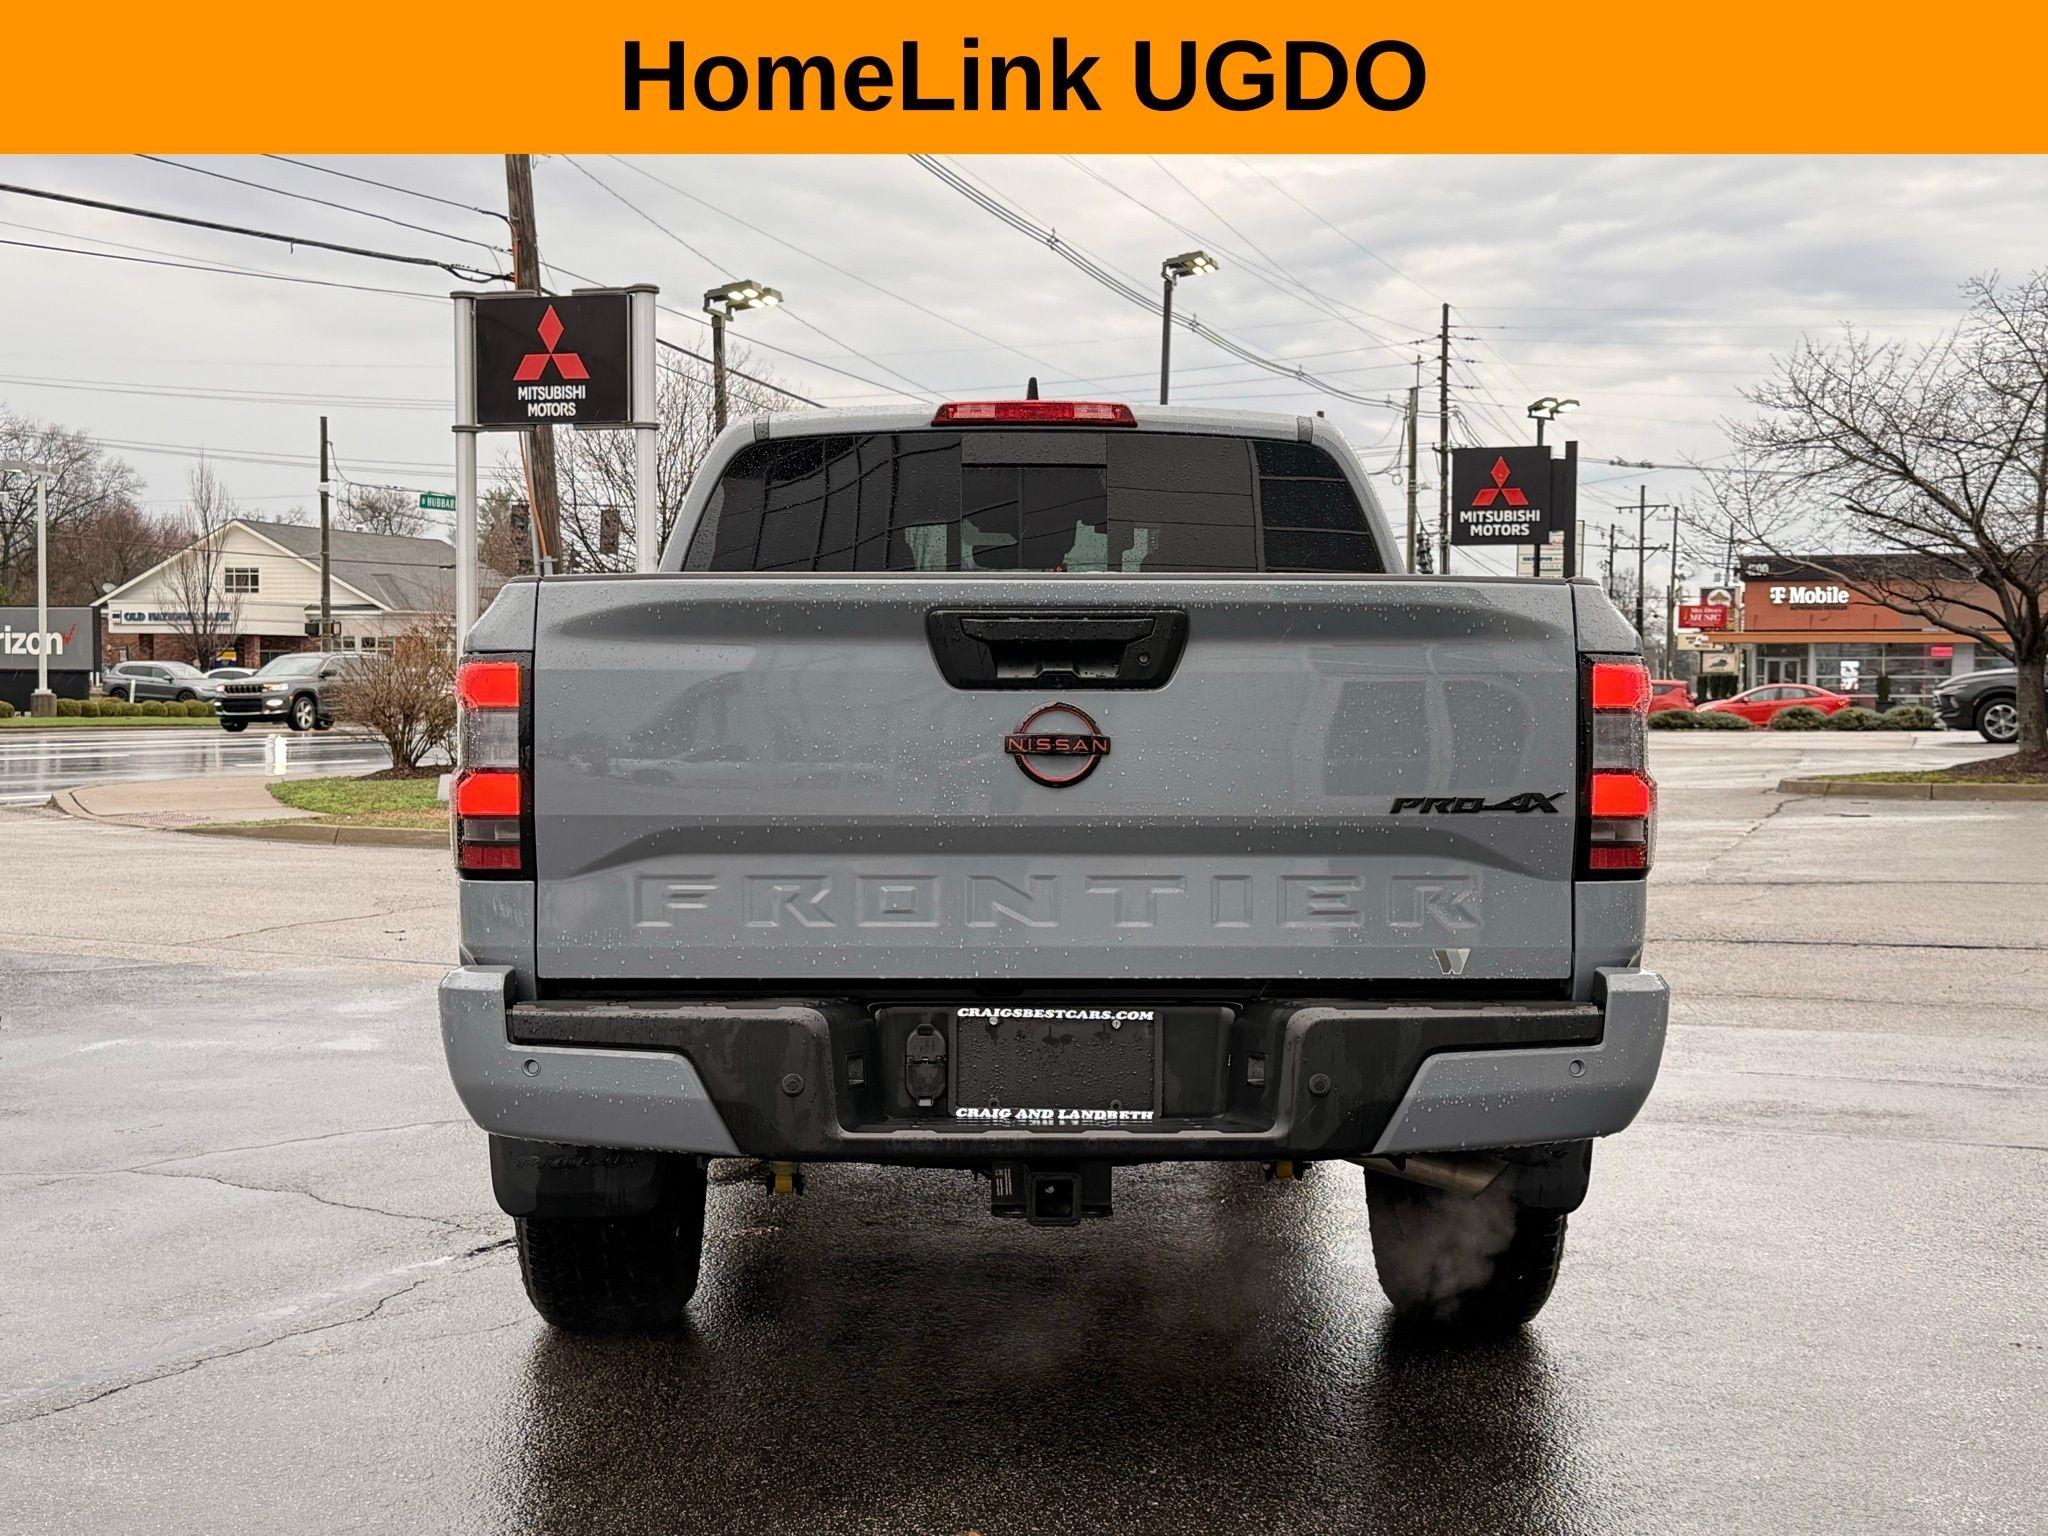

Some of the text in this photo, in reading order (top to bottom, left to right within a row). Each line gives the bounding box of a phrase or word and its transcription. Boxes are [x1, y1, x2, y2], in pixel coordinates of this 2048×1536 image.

[517, 385, 586, 401] MITSUBISHI
[527, 402, 577, 417] MOTORS
[1460, 510, 1540, 522] MITSUBISHI
[1470, 524, 1529, 536] MOTORS
[123, 612, 146, 622] OLD
[1008, 737, 1108, 752] NISSAN
[632, 873, 1484, 930] FRONTIER
[957, 1007, 1155, 1021] CRAIGSBESTCARS.COM
[955, 1107, 1011, 1119] CRAIG
[1015, 1108, 1054, 1120] AND
